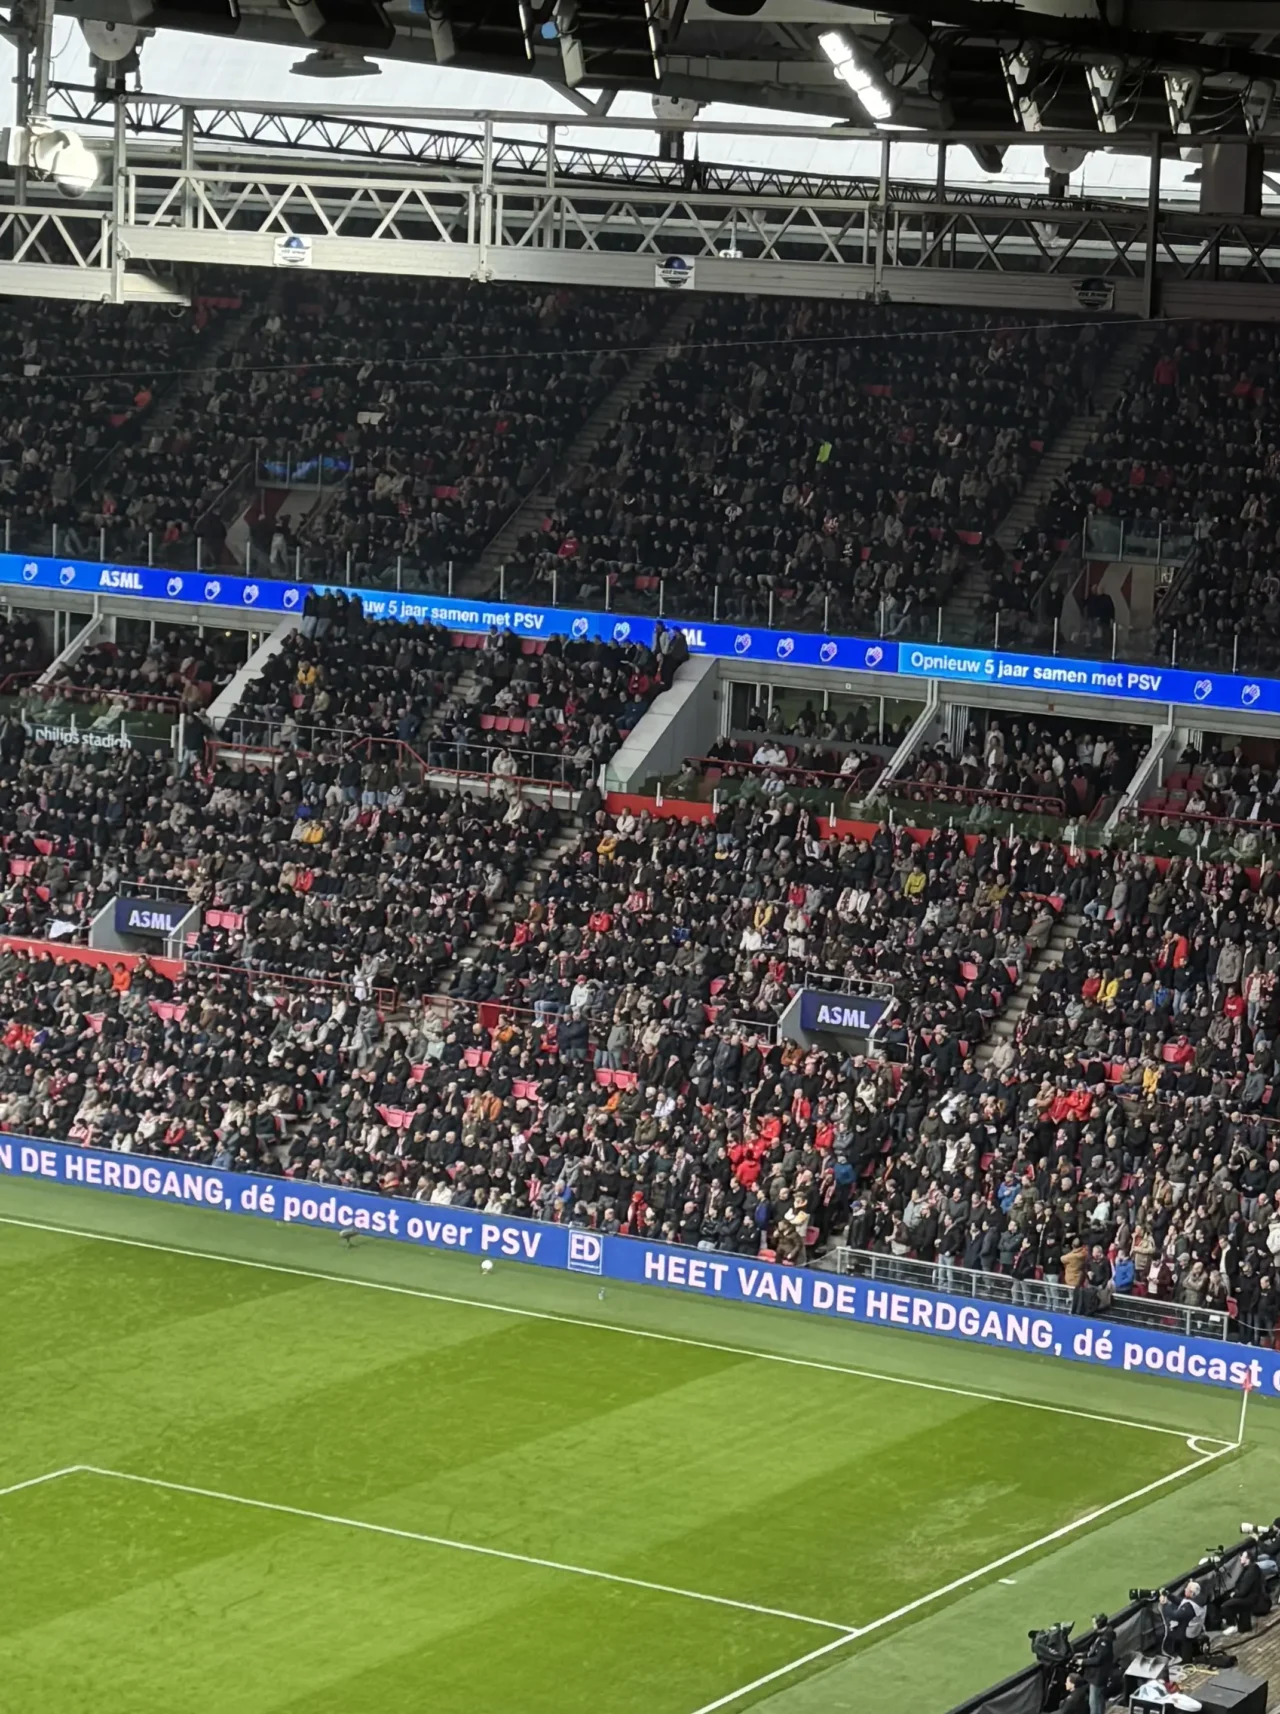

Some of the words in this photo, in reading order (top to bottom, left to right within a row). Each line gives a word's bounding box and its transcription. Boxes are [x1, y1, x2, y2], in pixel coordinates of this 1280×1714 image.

[99, 569, 144, 590] ASML
[388, 600, 398, 614] 5
[401, 601, 429, 617] jaar
[431, 607, 479, 623] samen
[482, 612, 511, 627] met
[513, 612, 544, 630] PSV
[911, 651, 980, 673] Opnieuw
[984, 659, 994, 674] 5
[998, 660, 1029, 679] jaar
[1033, 665, 1087, 684] samen
[1091, 672, 1123, 688] met
[1127, 673, 1162, 692] PSV
[128, 909, 175, 931] ASML
[817, 1005, 871, 1029] ASML
[21, 1147, 57, 1177] DE
[65, 1154, 232, 1211] HERDGANG,
[240, 1185, 276, 1214] dé
[283, 1195, 399, 1235] podcast
[407, 1217, 472, 1247] over
[481, 1224, 542, 1259] PSV
[570, 1233, 600, 1262] ED
[645, 1252, 729, 1291] HEET
[737, 1267, 803, 1305] VAN
[812, 1281, 856, 1314] DE
[865, 1289, 1063, 1357] HERDGANG,
[1073, 1328, 1113, 1360] dé
[1123, 1342, 1263, 1385] podcast
